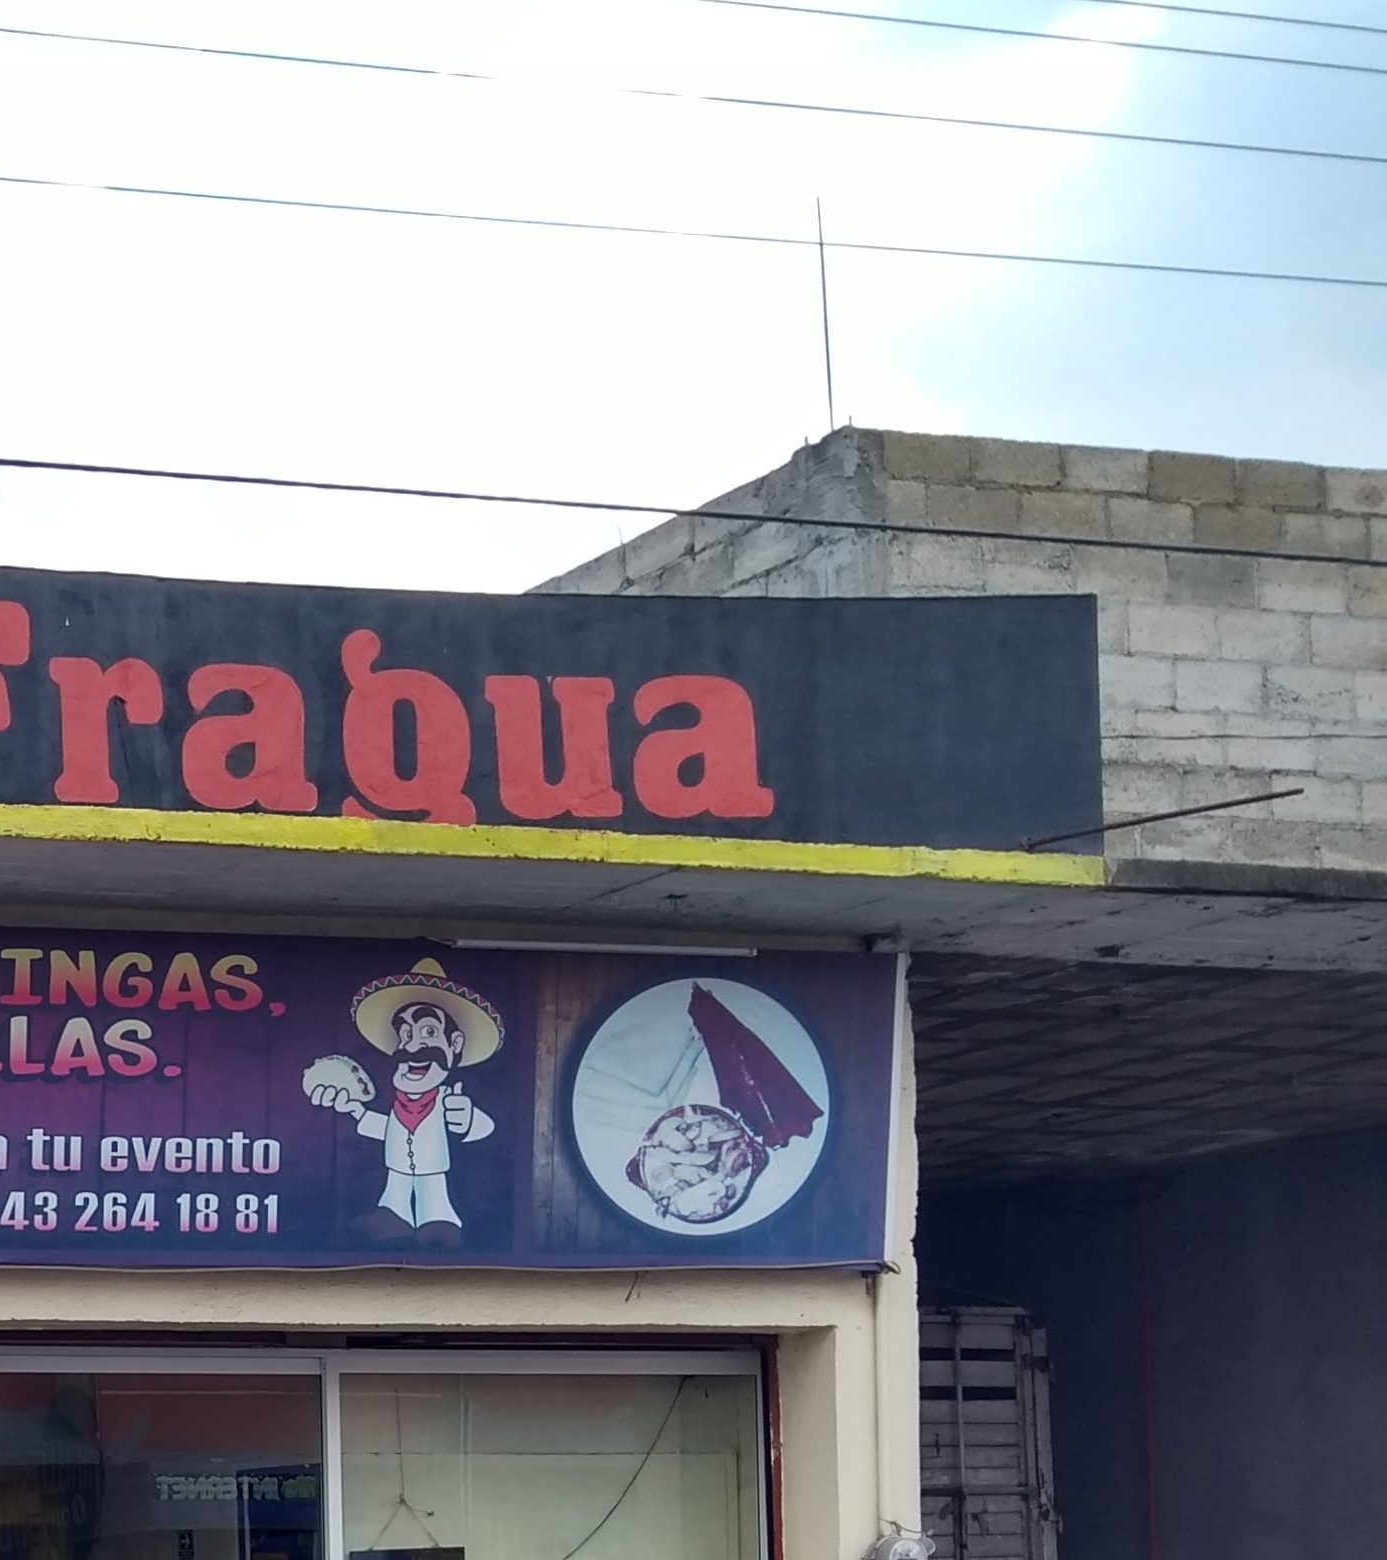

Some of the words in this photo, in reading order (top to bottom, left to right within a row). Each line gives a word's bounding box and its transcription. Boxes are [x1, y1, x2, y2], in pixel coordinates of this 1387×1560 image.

[28, 1127, 83, 1172] tu
[100, 1128, 281, 1175] evento
[74, 1192, 159, 1232] 264
[176, 1193, 220, 1233] 18
[233, 1193, 280, 1234] 81
